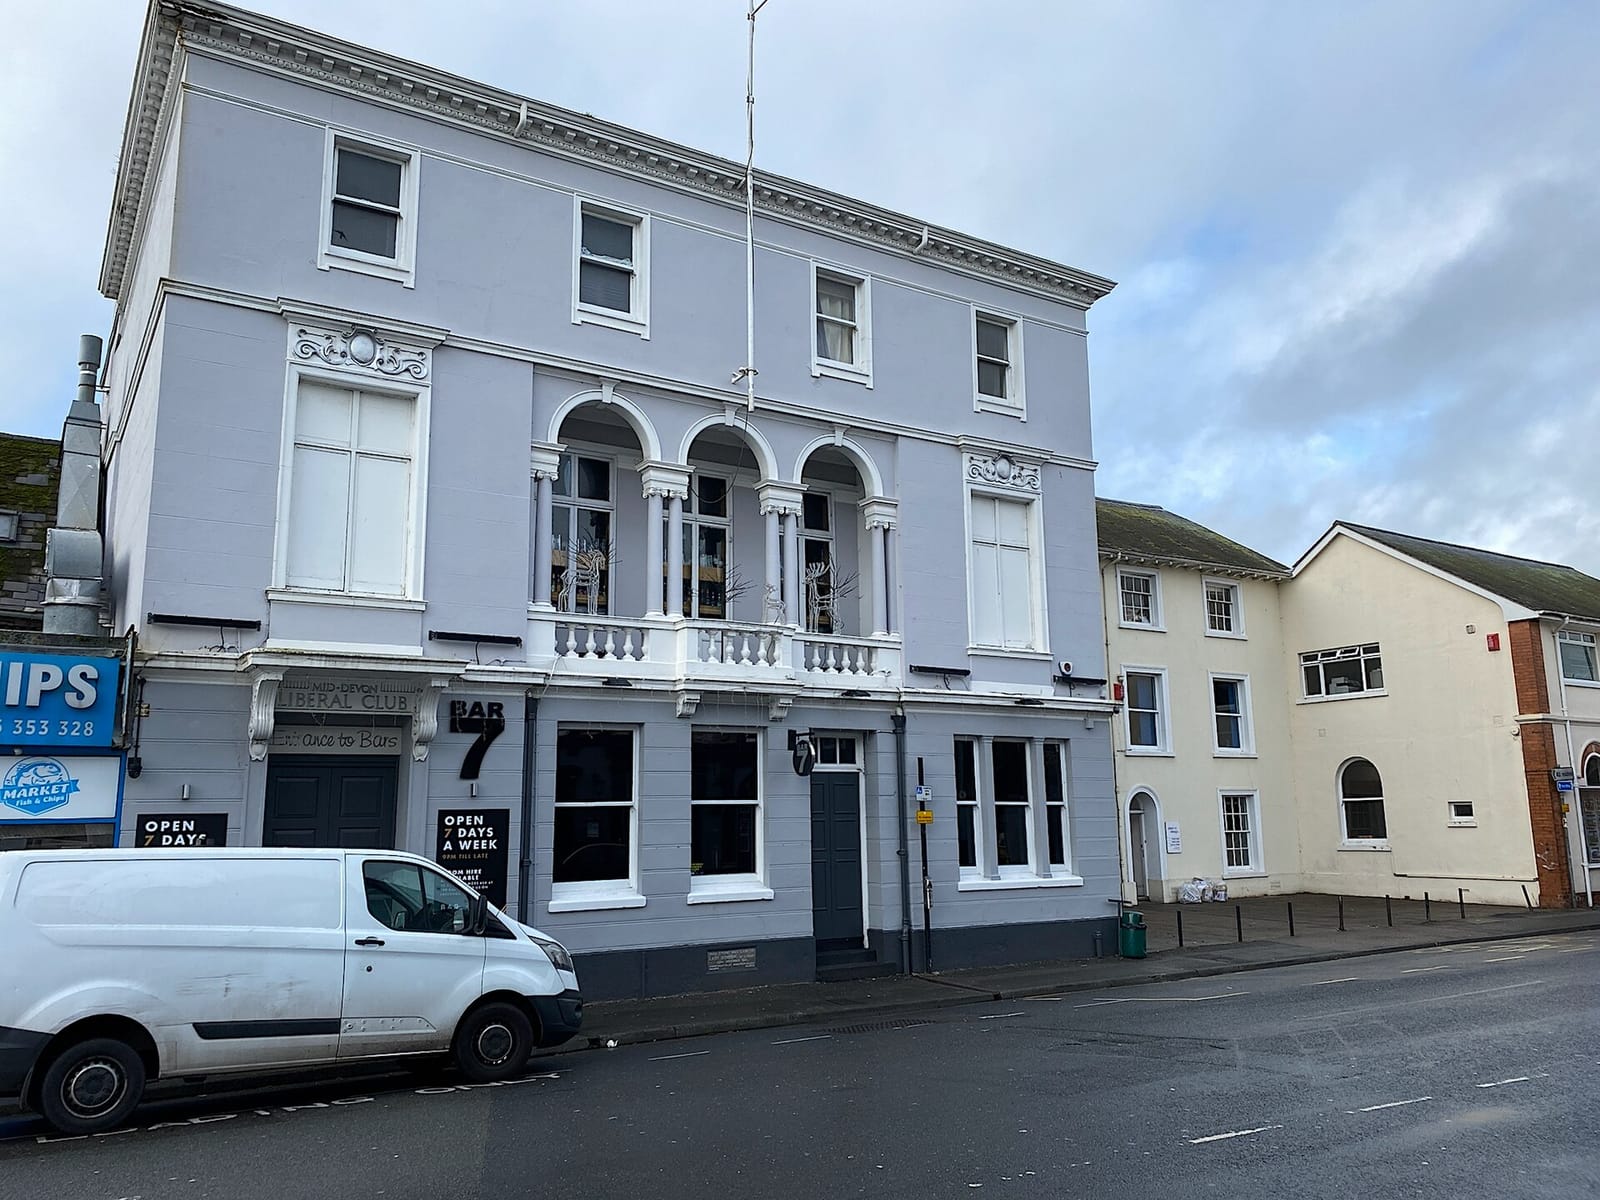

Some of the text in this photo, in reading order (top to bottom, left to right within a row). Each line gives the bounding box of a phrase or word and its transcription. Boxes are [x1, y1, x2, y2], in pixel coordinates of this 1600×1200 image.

[0, 662, 98, 709] IPS
[312, 682, 378, 694] MID-DEVON
[278, 691, 408, 710] LIBERAL CLUB
[450, 700, 505, 719] BAR
[12, 720, 49, 735] 353
[58, 721, 94, 736] 328
[273, 730, 399, 748] Enance to Bars
[449, 717, 506, 780] 7
[796, 750, 808, 774] 7
[3, 783, 70, 800] MARKET
[42, 795, 65, 803] Chips
[145, 820, 195, 832] OPEN
[444, 815, 484, 826] OPEN
[144, 834, 154, 847] 7
[444, 827, 494, 839] 7 DAYS
[443, 839, 498, 851] A WEEK
